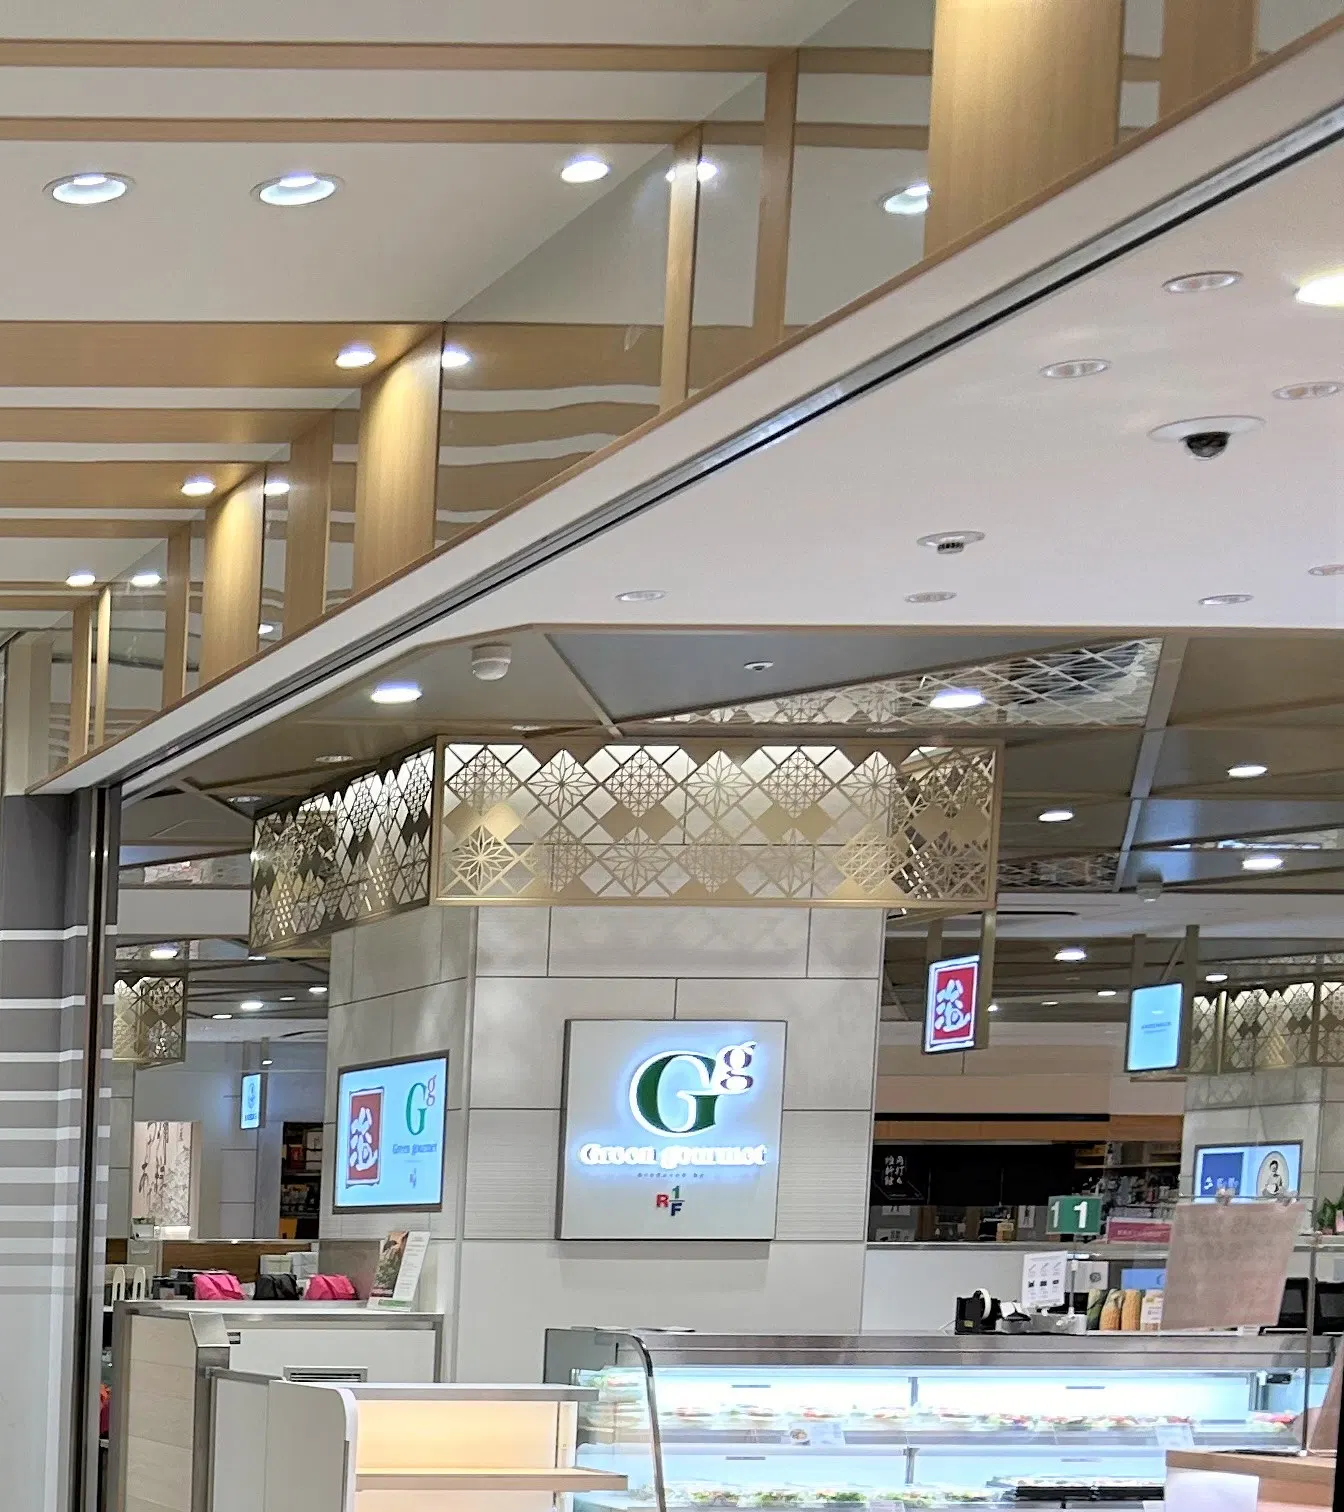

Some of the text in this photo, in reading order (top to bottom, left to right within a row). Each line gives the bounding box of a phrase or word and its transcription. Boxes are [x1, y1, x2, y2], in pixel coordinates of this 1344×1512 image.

[579, 1144, 767, 1169] Green gourmet
[1073, 1200, 1088, 1229] 1
